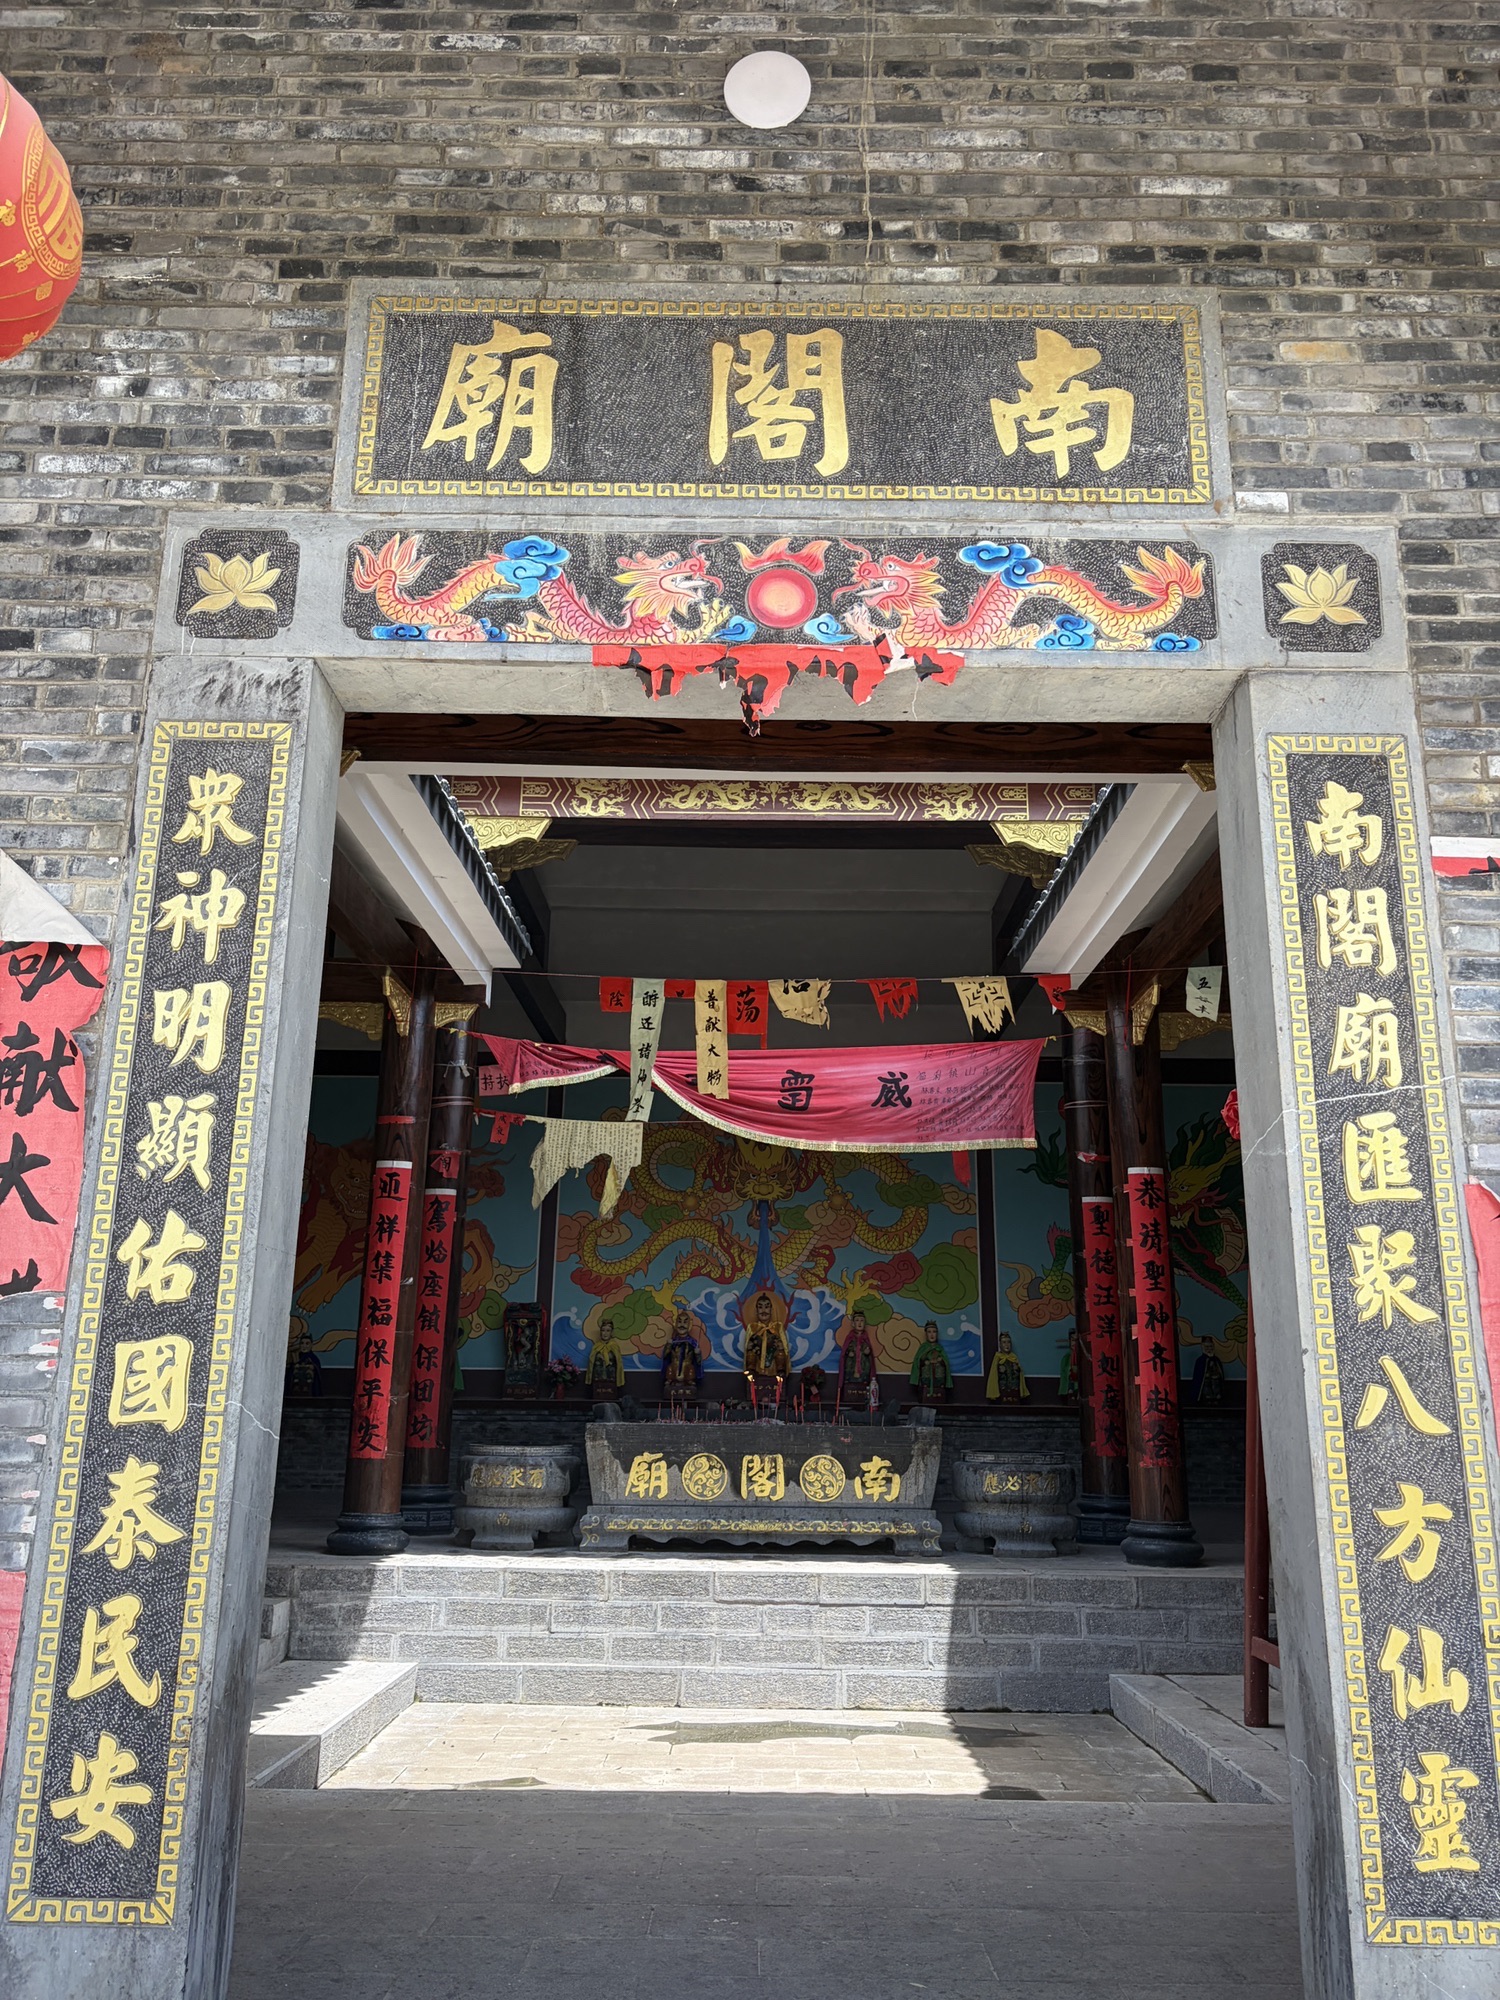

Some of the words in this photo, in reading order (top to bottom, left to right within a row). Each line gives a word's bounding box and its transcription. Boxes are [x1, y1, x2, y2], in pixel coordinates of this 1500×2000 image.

[422, 320, 1134, 479] 南閣廟
[1305, 780, 1480, 1873] 南閣廟匯聚八方仙靈
[624, 1452, 902, 1503] 南閣廟
